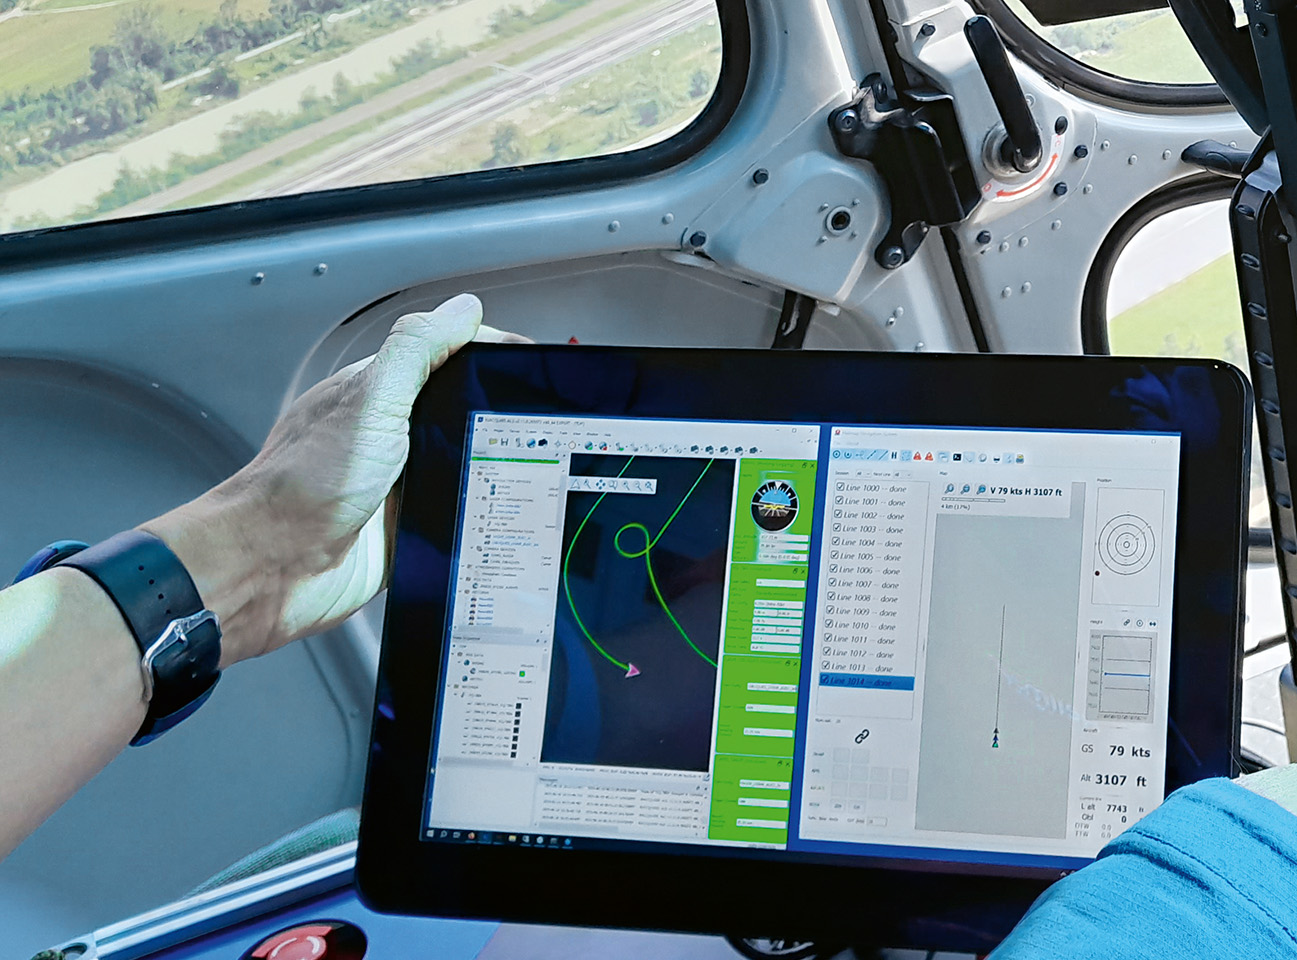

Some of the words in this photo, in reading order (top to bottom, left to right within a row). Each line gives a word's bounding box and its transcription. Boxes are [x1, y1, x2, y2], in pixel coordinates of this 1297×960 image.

[846, 484, 861, 492] Line
[864, 484, 880, 492] 1000
[889, 485, 907, 493] done
[998, 487, 1008, 495] 79
[1034, 488, 1053, 496] 3107
[1055, 489, 1063, 497] ft
[862, 498, 879, 506] 1001
[888, 499, 906, 507] done
[842, 525, 858, 533] Line
[860, 525, 877, 533] 1003
[885, 540, 903, 548] done
[884, 554, 902, 562] done
[839, 566, 854, 574] Line
[856, 580, 872, 588] 1007
[881, 595, 898, 603] done
[836, 607, 851, 615] Line
[880, 609, 897, 617] done
[835, 621, 850, 629] Line
[852, 622, 869, 630] 1010
[879, 623, 896, 631] done
[851, 635, 868, 643] 1011
[877, 637, 895, 645] done
[876, 651, 894, 659] done
[875, 665, 893, 673] done
[1081, 744, 1093, 753] GS
[1109, 745, 1125, 756] 79
[1132, 746, 1151, 758] kts
[1080, 774, 1091, 782] Alt
[1095, 774, 1127, 786] 3107
[1136, 776, 1147, 787] ft
[1106, 804, 1127, 813] 7743
[1121, 815, 1127, 823] 0
